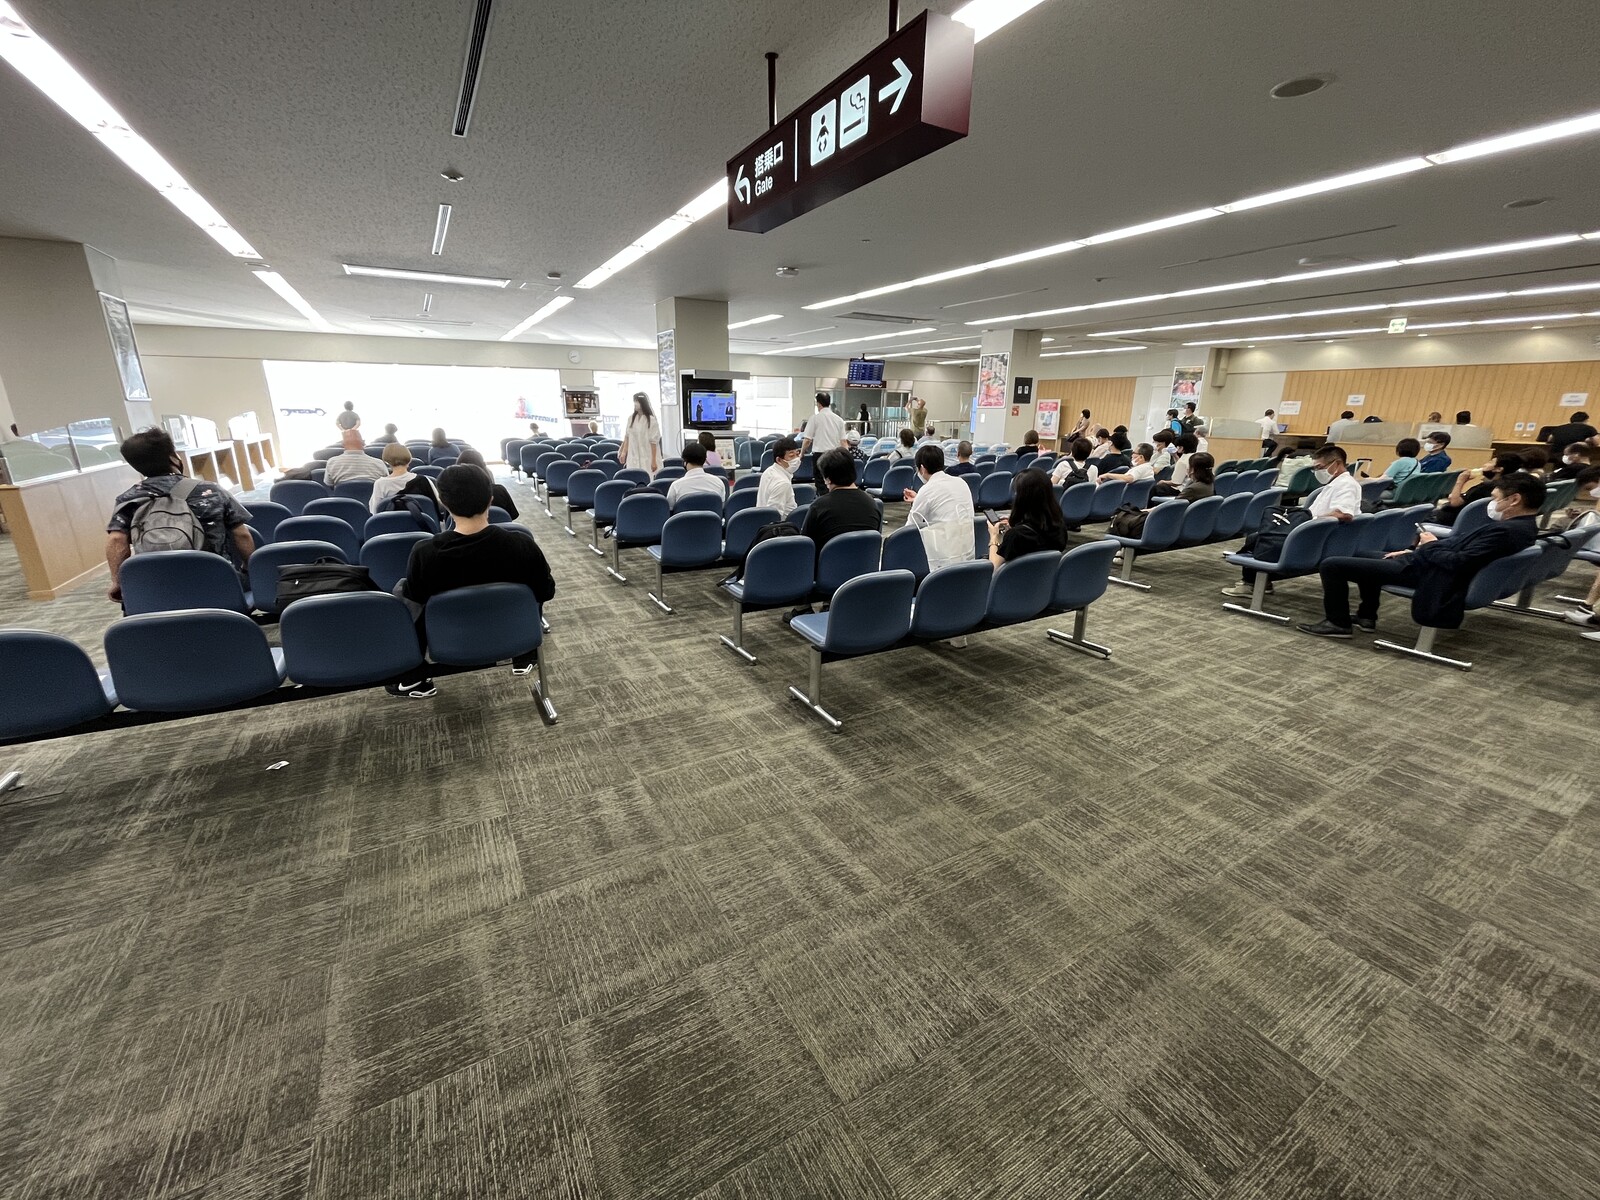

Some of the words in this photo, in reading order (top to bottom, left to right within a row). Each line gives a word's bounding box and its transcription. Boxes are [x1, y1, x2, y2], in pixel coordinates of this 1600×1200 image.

[755, 141, 783, 178] 搭乗口
[755, 176, 773, 196] Gate
